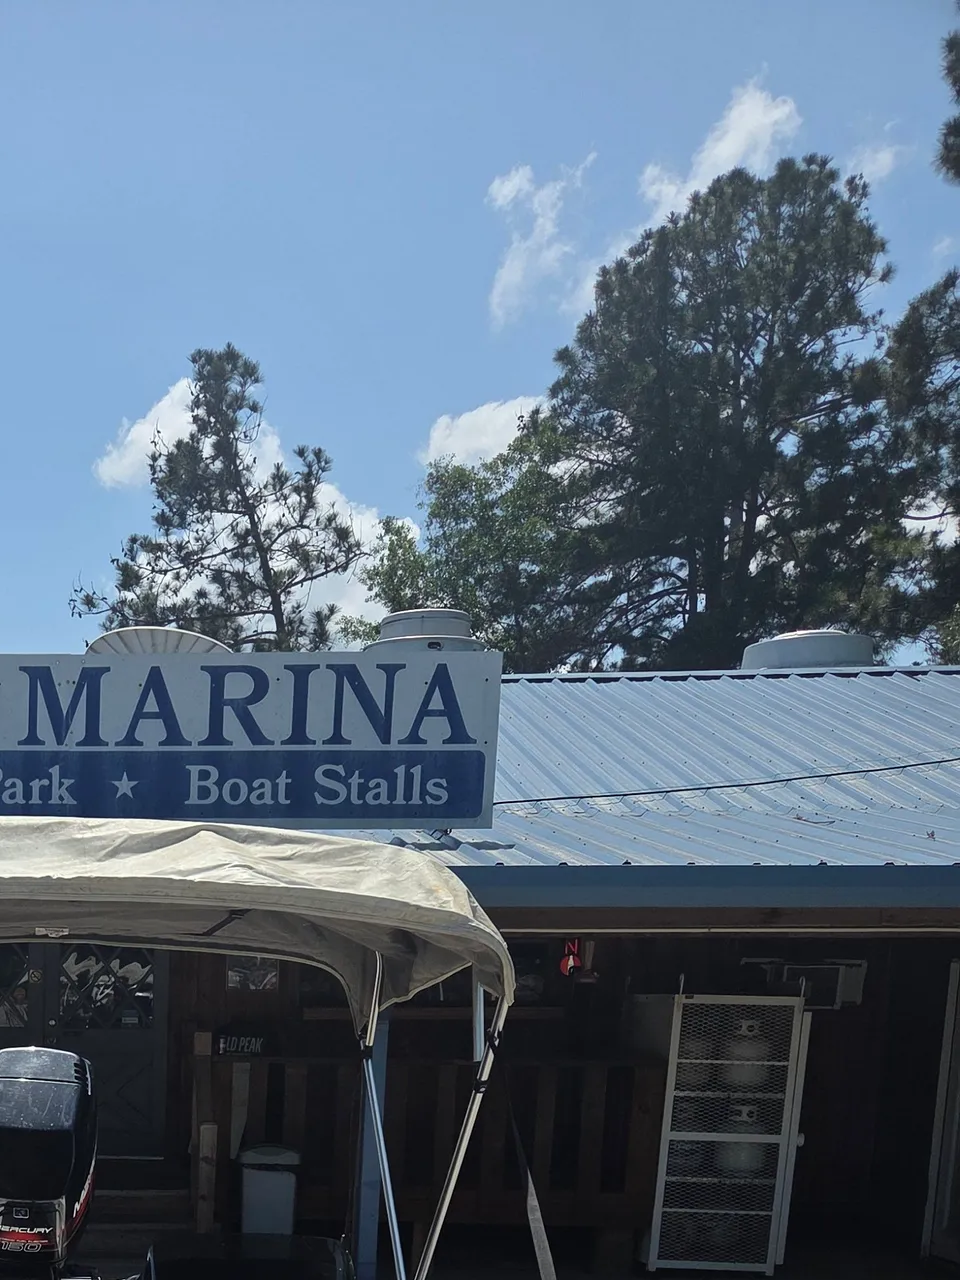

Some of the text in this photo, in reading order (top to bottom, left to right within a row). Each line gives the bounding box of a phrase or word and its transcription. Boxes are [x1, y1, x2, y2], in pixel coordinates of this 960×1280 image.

[18, 663, 478, 746] MARINA
[185, 765, 292, 805] Boat
[314, 764, 449, 805] Stalls
[238, 1036, 264, 1053] PEAK
[1, 1240, 42, 1253] 150
